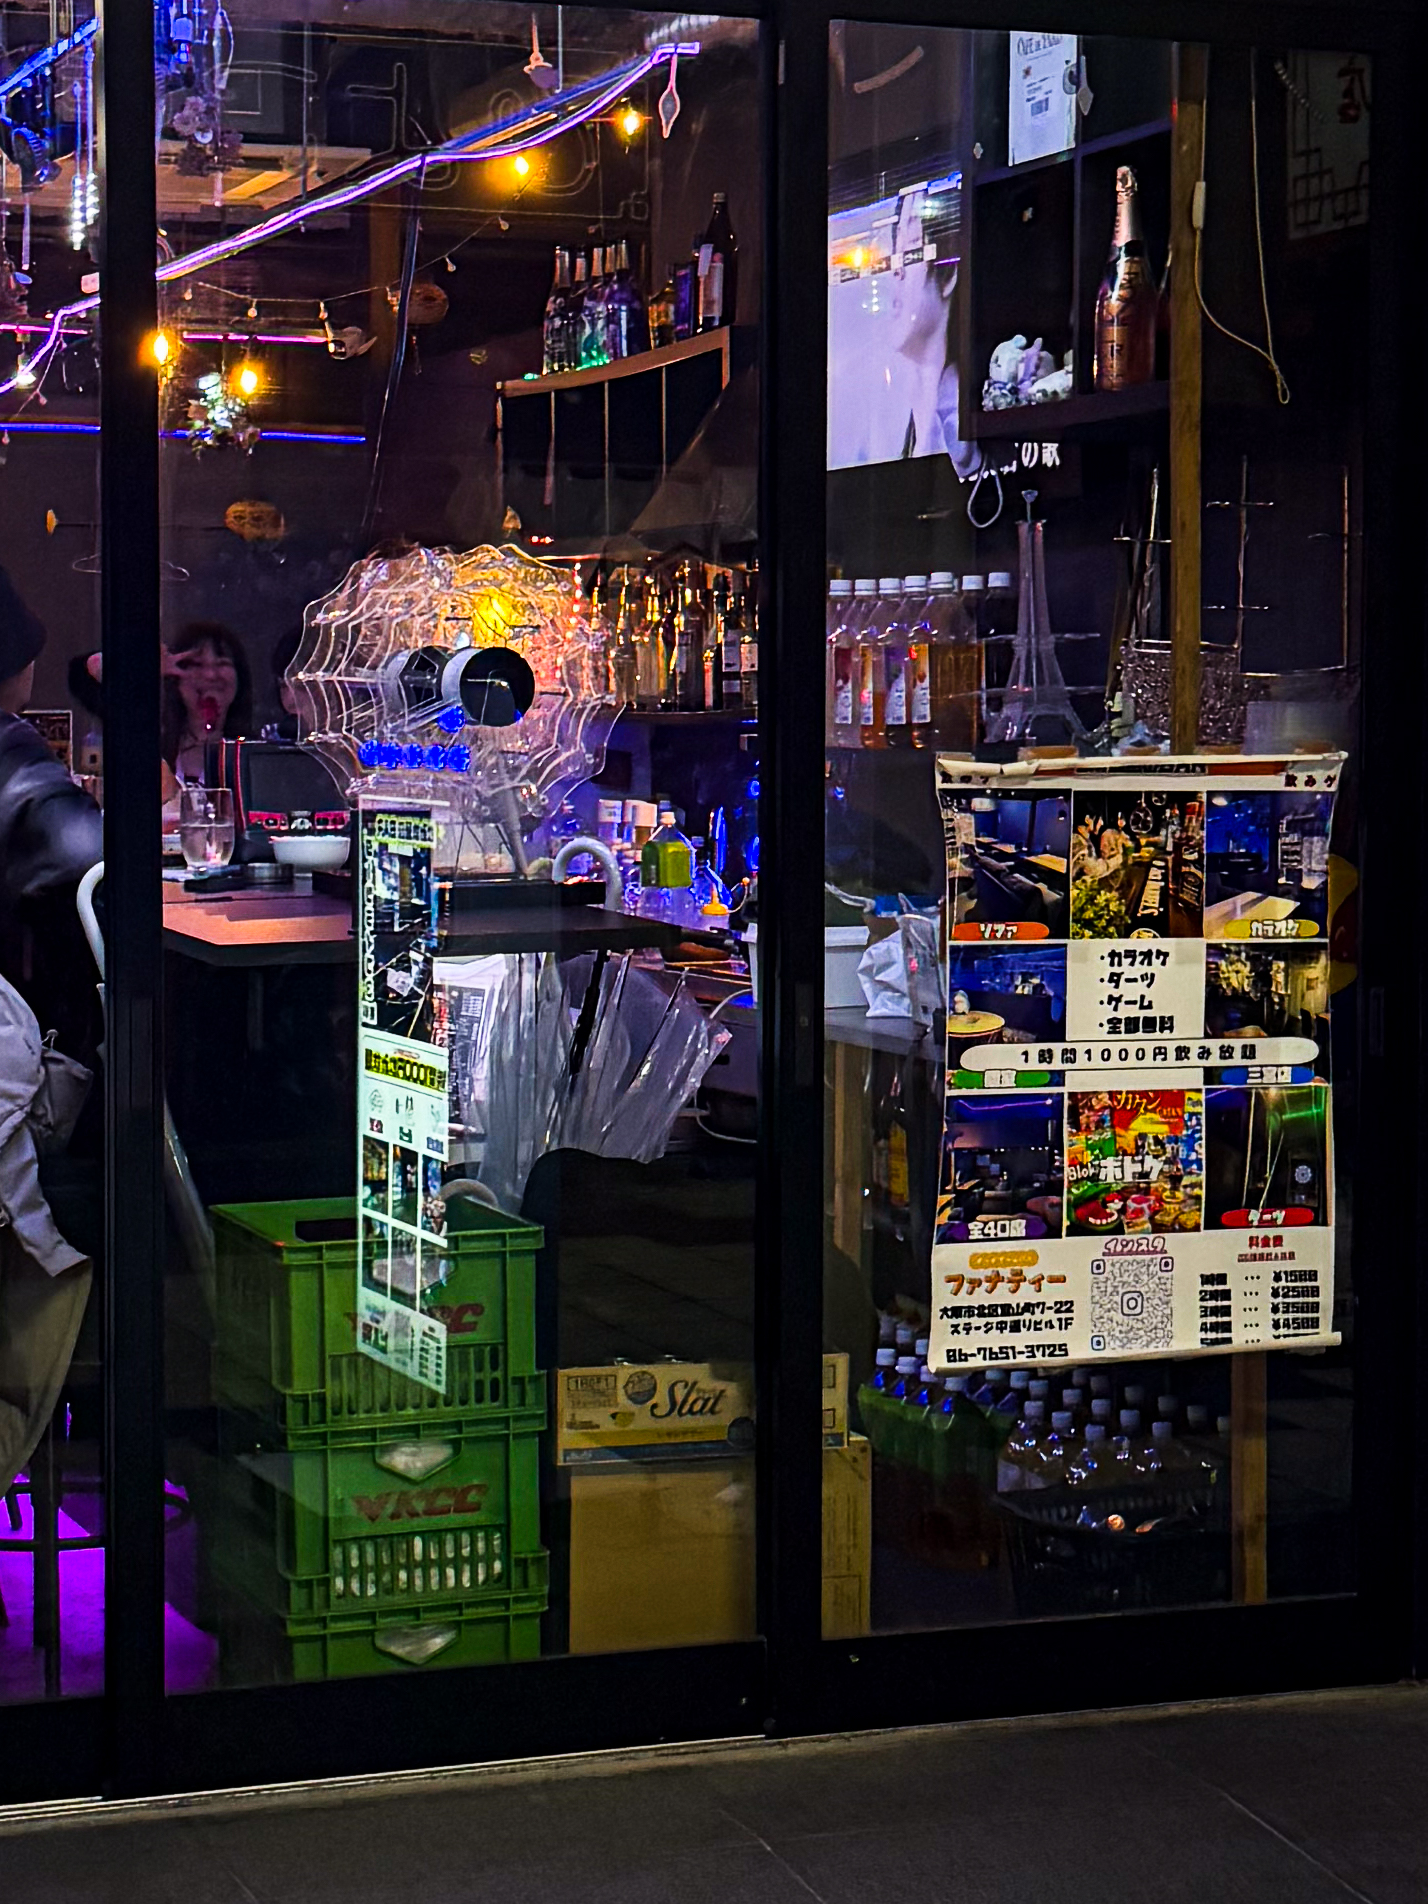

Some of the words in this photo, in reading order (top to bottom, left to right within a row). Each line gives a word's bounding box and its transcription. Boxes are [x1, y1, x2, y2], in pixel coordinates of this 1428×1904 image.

[1249, 918, 1300, 938] カラオケ
[1103, 1236, 1168, 1254] インスタ
[944, 1269, 1067, 1296] ファナティー
[649, 1378, 728, 1419] Slat
